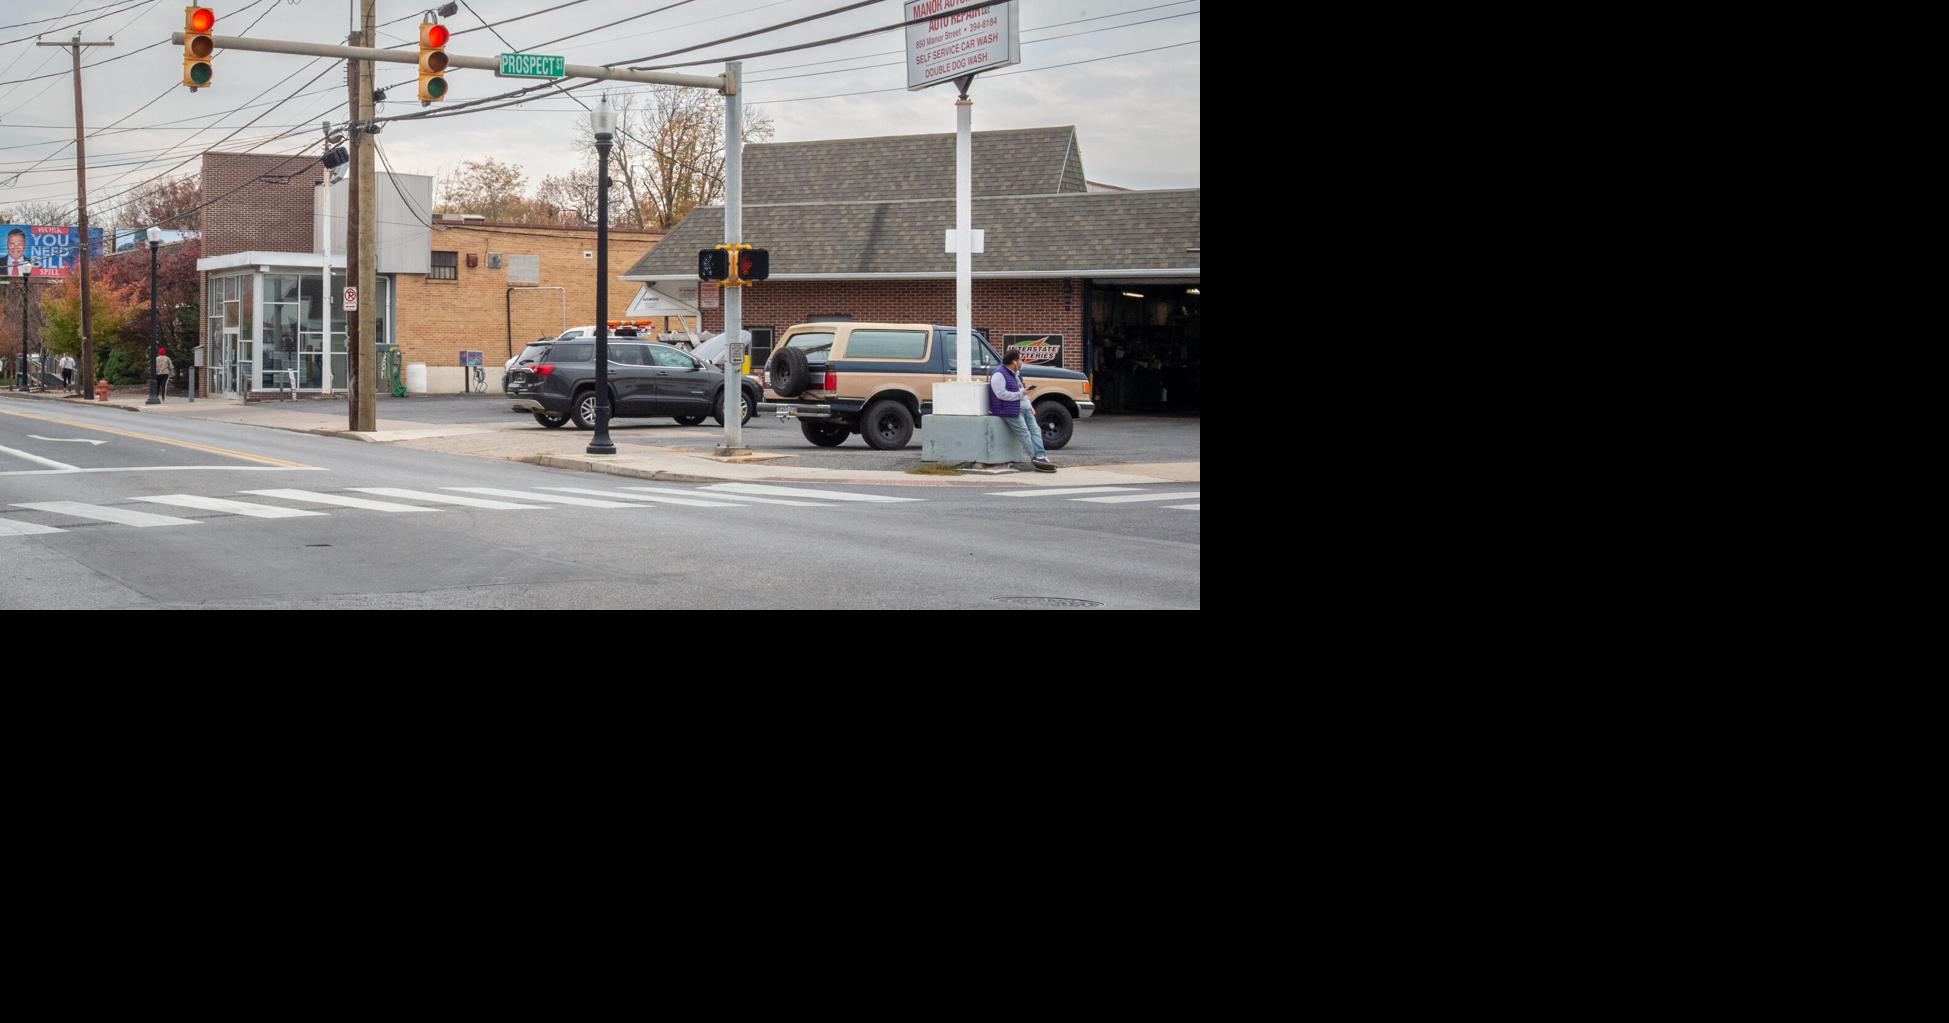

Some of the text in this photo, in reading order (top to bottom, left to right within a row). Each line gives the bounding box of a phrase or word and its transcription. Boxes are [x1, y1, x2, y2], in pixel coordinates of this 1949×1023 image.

[913, 0, 941, 20] MANOR
[928, 15, 949, 33] AUTO
[951, 7, 980, 25] REPAIR
[926, 34, 943, 46] Manor
[944, 27, 961, 40] Street
[916, 33, 999, 65] SELF SERVICE CAR WASH
[502, 55, 563, 75] PROSPECT ST
[925, 52, 988, 78] DOUBLE DOG WASH
[31, 234, 69, 246] YOU
[31, 246, 70, 257] NEED
[40, 268, 60, 276] SPILL
